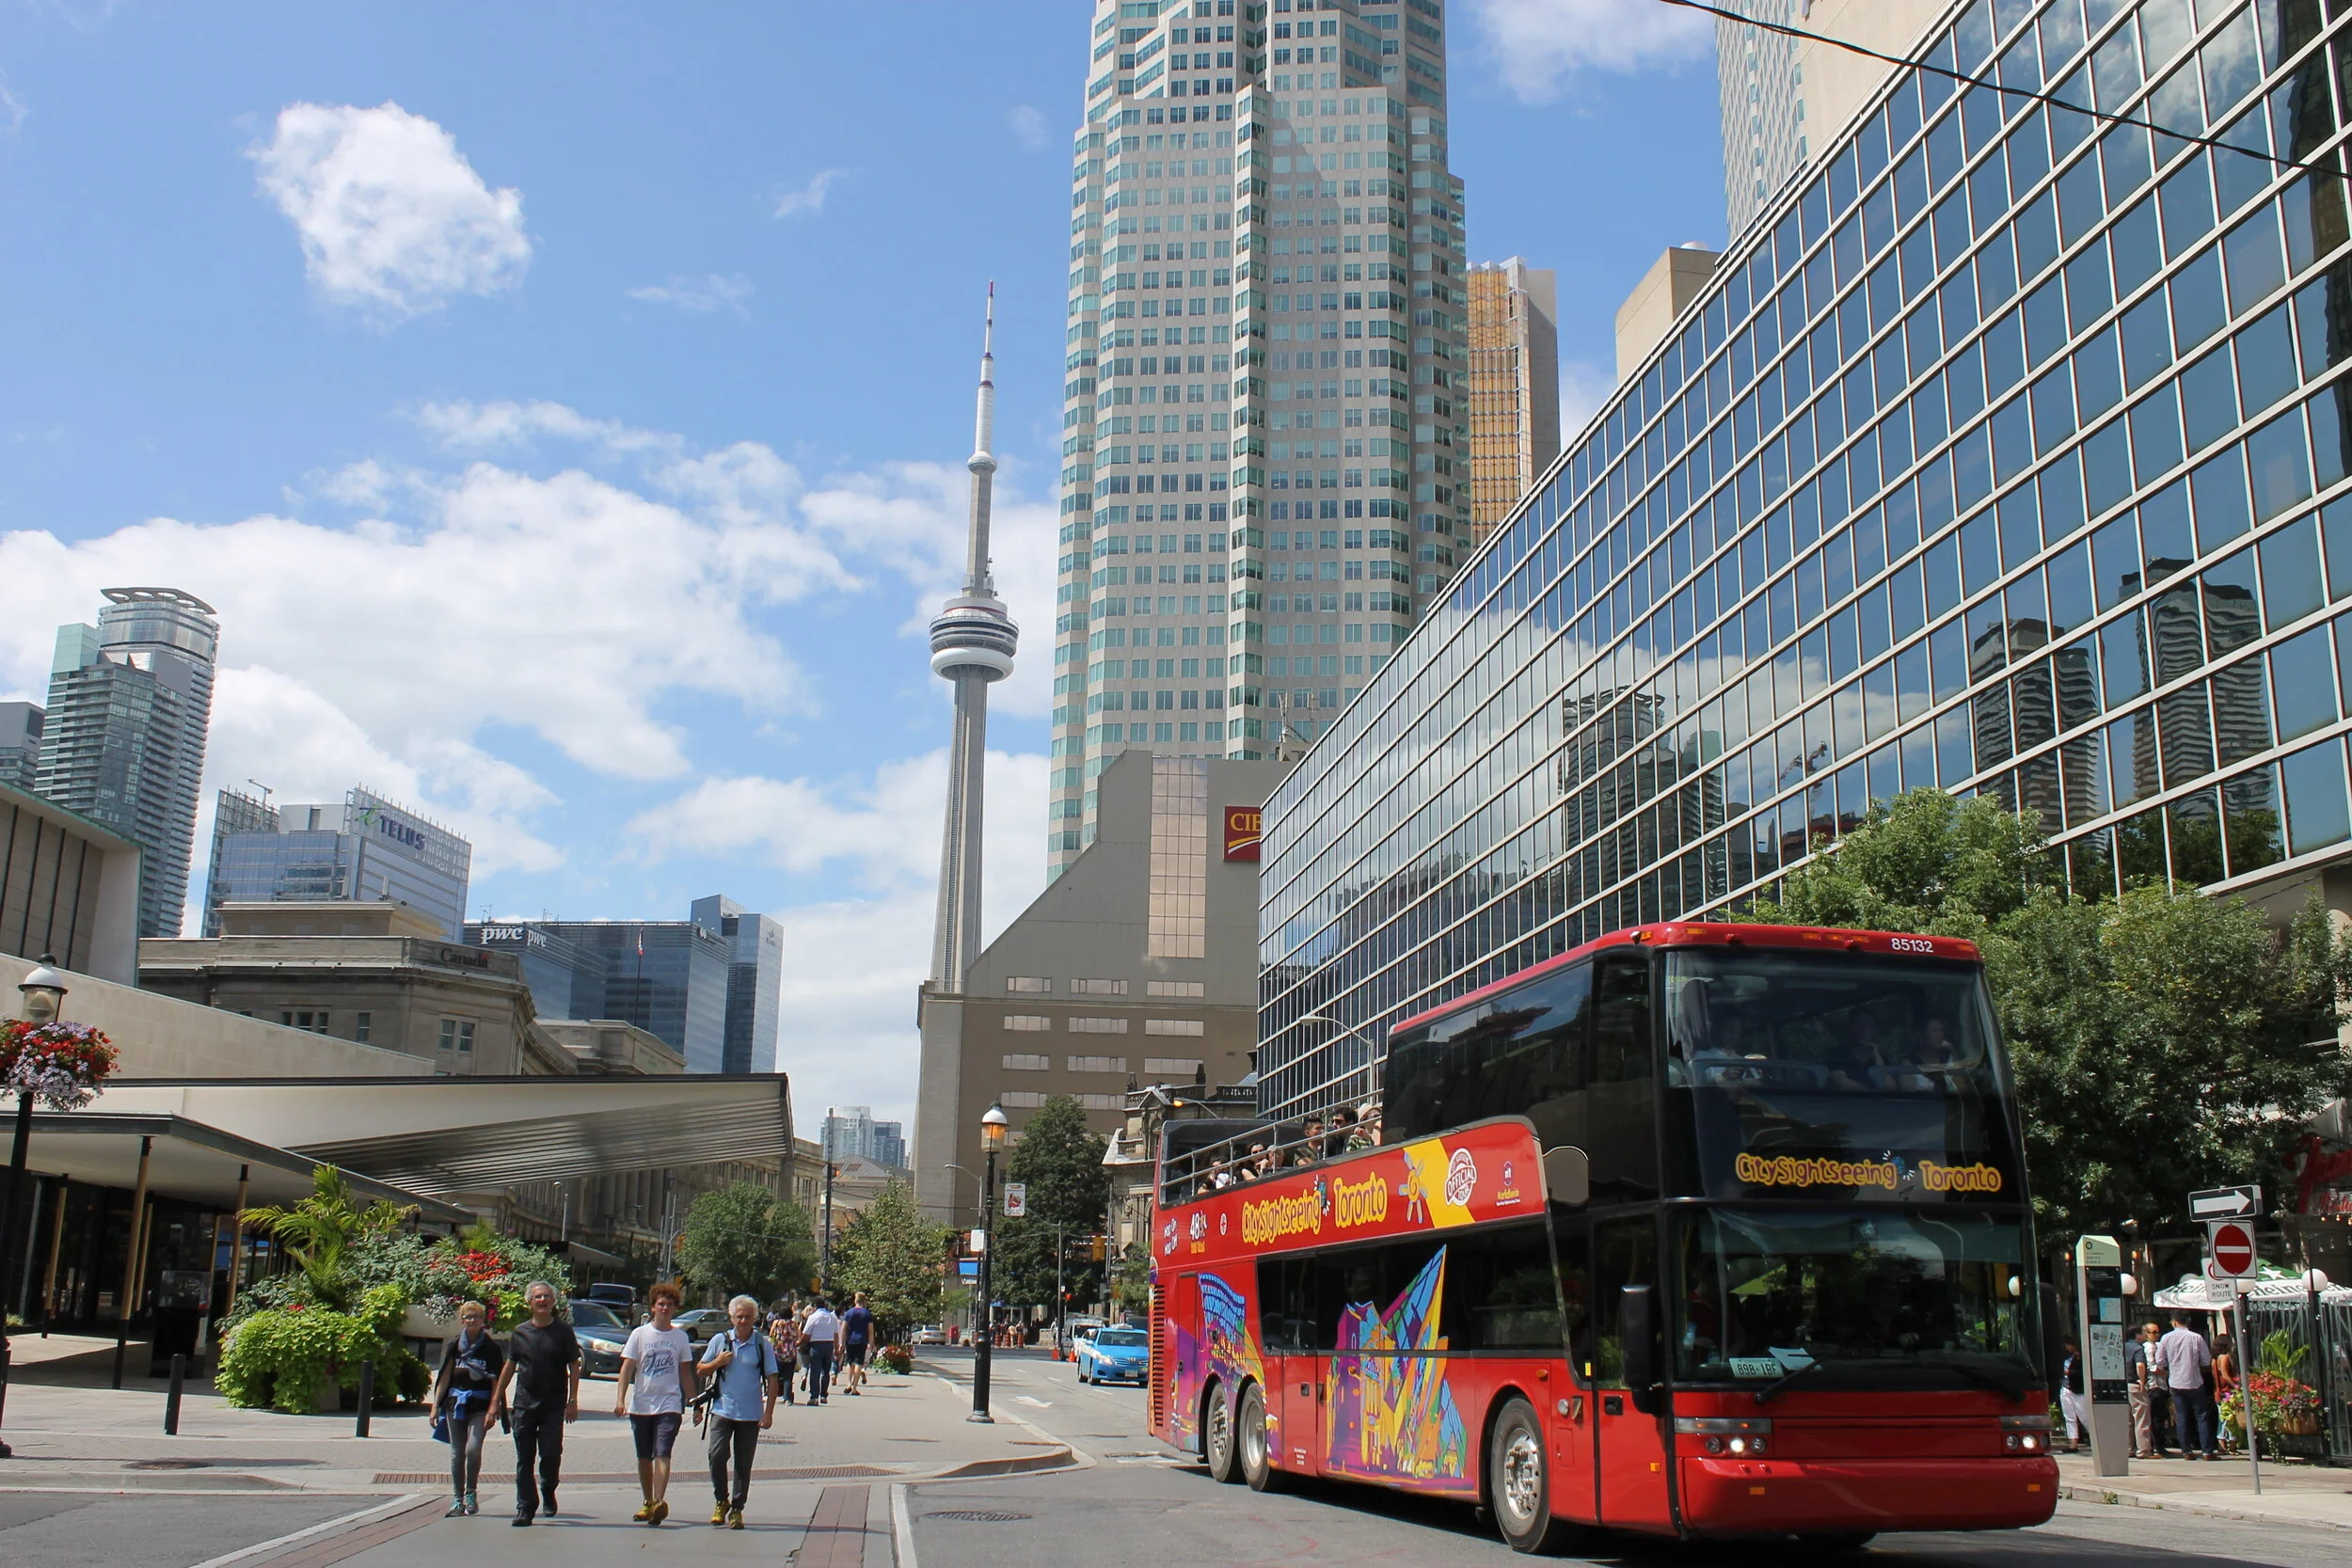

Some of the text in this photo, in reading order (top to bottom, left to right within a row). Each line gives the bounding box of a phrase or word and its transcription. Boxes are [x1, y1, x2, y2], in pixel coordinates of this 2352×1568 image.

[380, 816, 425, 850] TELUS
[1230, 813, 1261, 832] CIB
[481, 927, 523, 945] pwc
[527, 929, 547, 948] pwc
[1891, 938, 1934, 953] 85132
[441, 947, 488, 969] Canada
[1447, 1167, 1474, 1197] OFFICIAL
[1736, 1153, 2002, 1192] CitySightseeing Toronto
[1242, 1189, 1322, 1246] CitySightseeing
[1333, 1171, 1388, 1227] Toronto
[1189, 1212, 1200, 1241] 48
